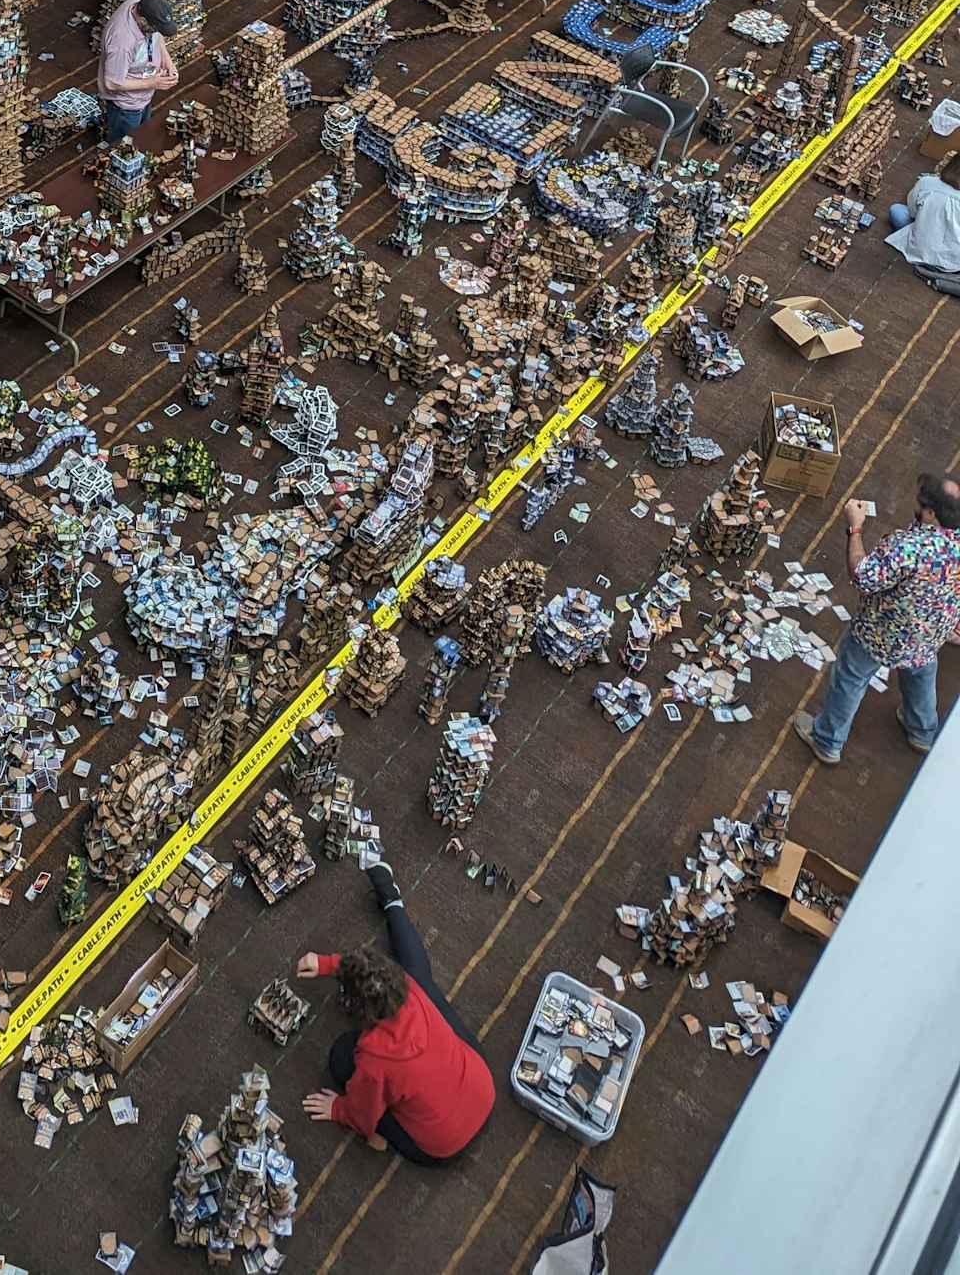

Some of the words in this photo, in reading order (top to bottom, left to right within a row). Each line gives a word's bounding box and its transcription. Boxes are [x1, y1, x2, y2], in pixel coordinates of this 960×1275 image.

[445, 517, 475, 550] CABLE-PATH
[283, 691, 319, 731] CABLE-PATH
[236, 739, 274, 783] CABLE-PATH
[187, 791, 227, 838] CABLE-PATH
[134, 850, 176, 898] CABLE-PATH
[76, 909, 123, 962] CABLE-PATH
[16, 974, 65, 1029] CABLE-PATH
